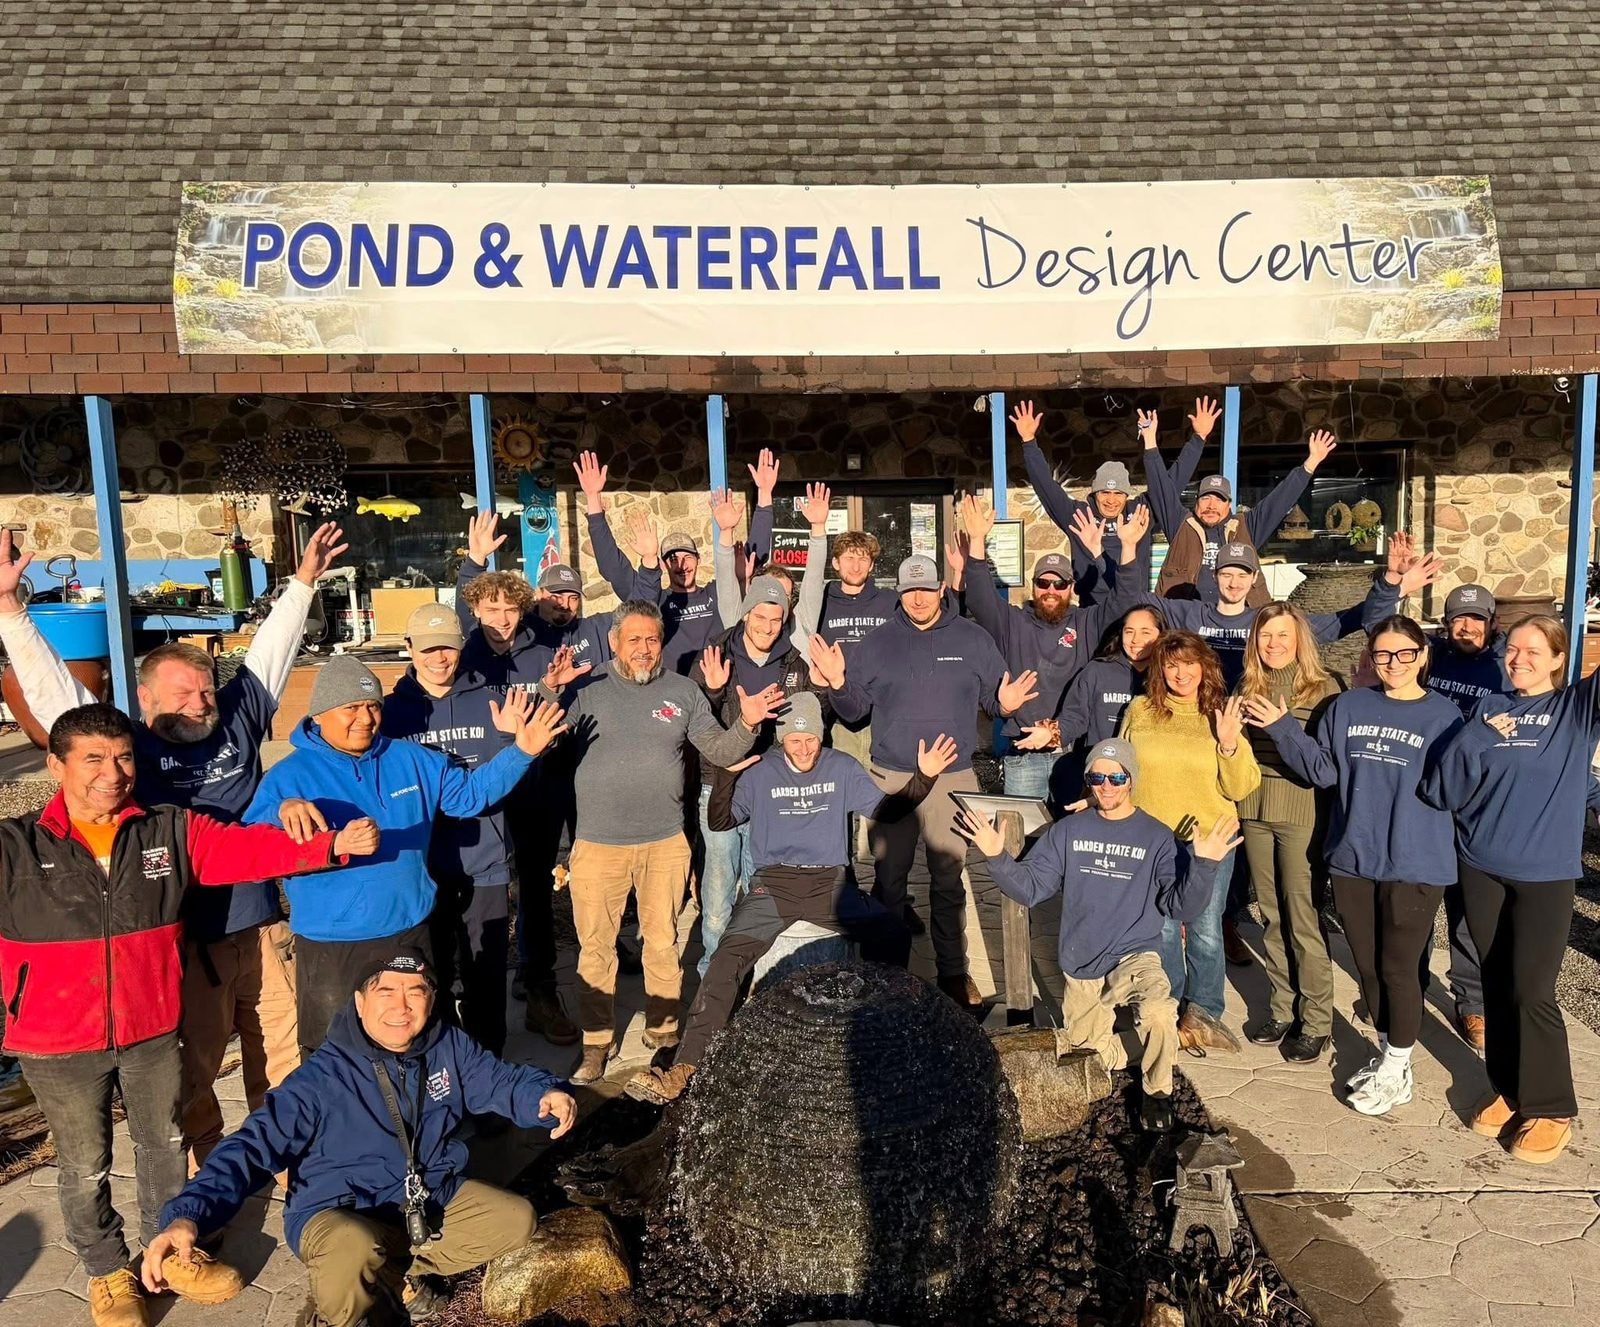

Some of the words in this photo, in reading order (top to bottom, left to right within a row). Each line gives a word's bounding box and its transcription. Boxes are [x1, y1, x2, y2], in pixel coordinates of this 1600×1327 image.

[243, 221, 454, 289] POND
[473, 222, 523, 288] &
[540, 224, 941, 290] WATERFALL
[966, 216, 1200, 340] Design
[1217, 211, 1434, 283] Center
[774, 535, 797, 547] Sorry
[773, 549, 808, 565] CLOSE
[829, 617, 853, 628] GARDEN
[855, 617, 874, 626] STATE
[1225, 628, 1246, 638] STATE
[1451, 681, 1476, 695] STATE
[1536, 714, 1552, 726] KO
[439, 727, 468, 743] STATE
[469, 726, 485, 739] KOI
[1347, 725, 1380, 738] GARDEN
[1380, 726, 1409, 743] STATE
[1407, 733, 1425, 749] KOI
[771, 787, 799, 799] GARDEN
[800, 783, 822, 797] STATE
[823, 782, 835, 793] KOI
[1073, 839, 1104, 854] GARDEN
[1105, 843, 1131, 857] STATE
[1131, 846, 1147, 861] KOI
